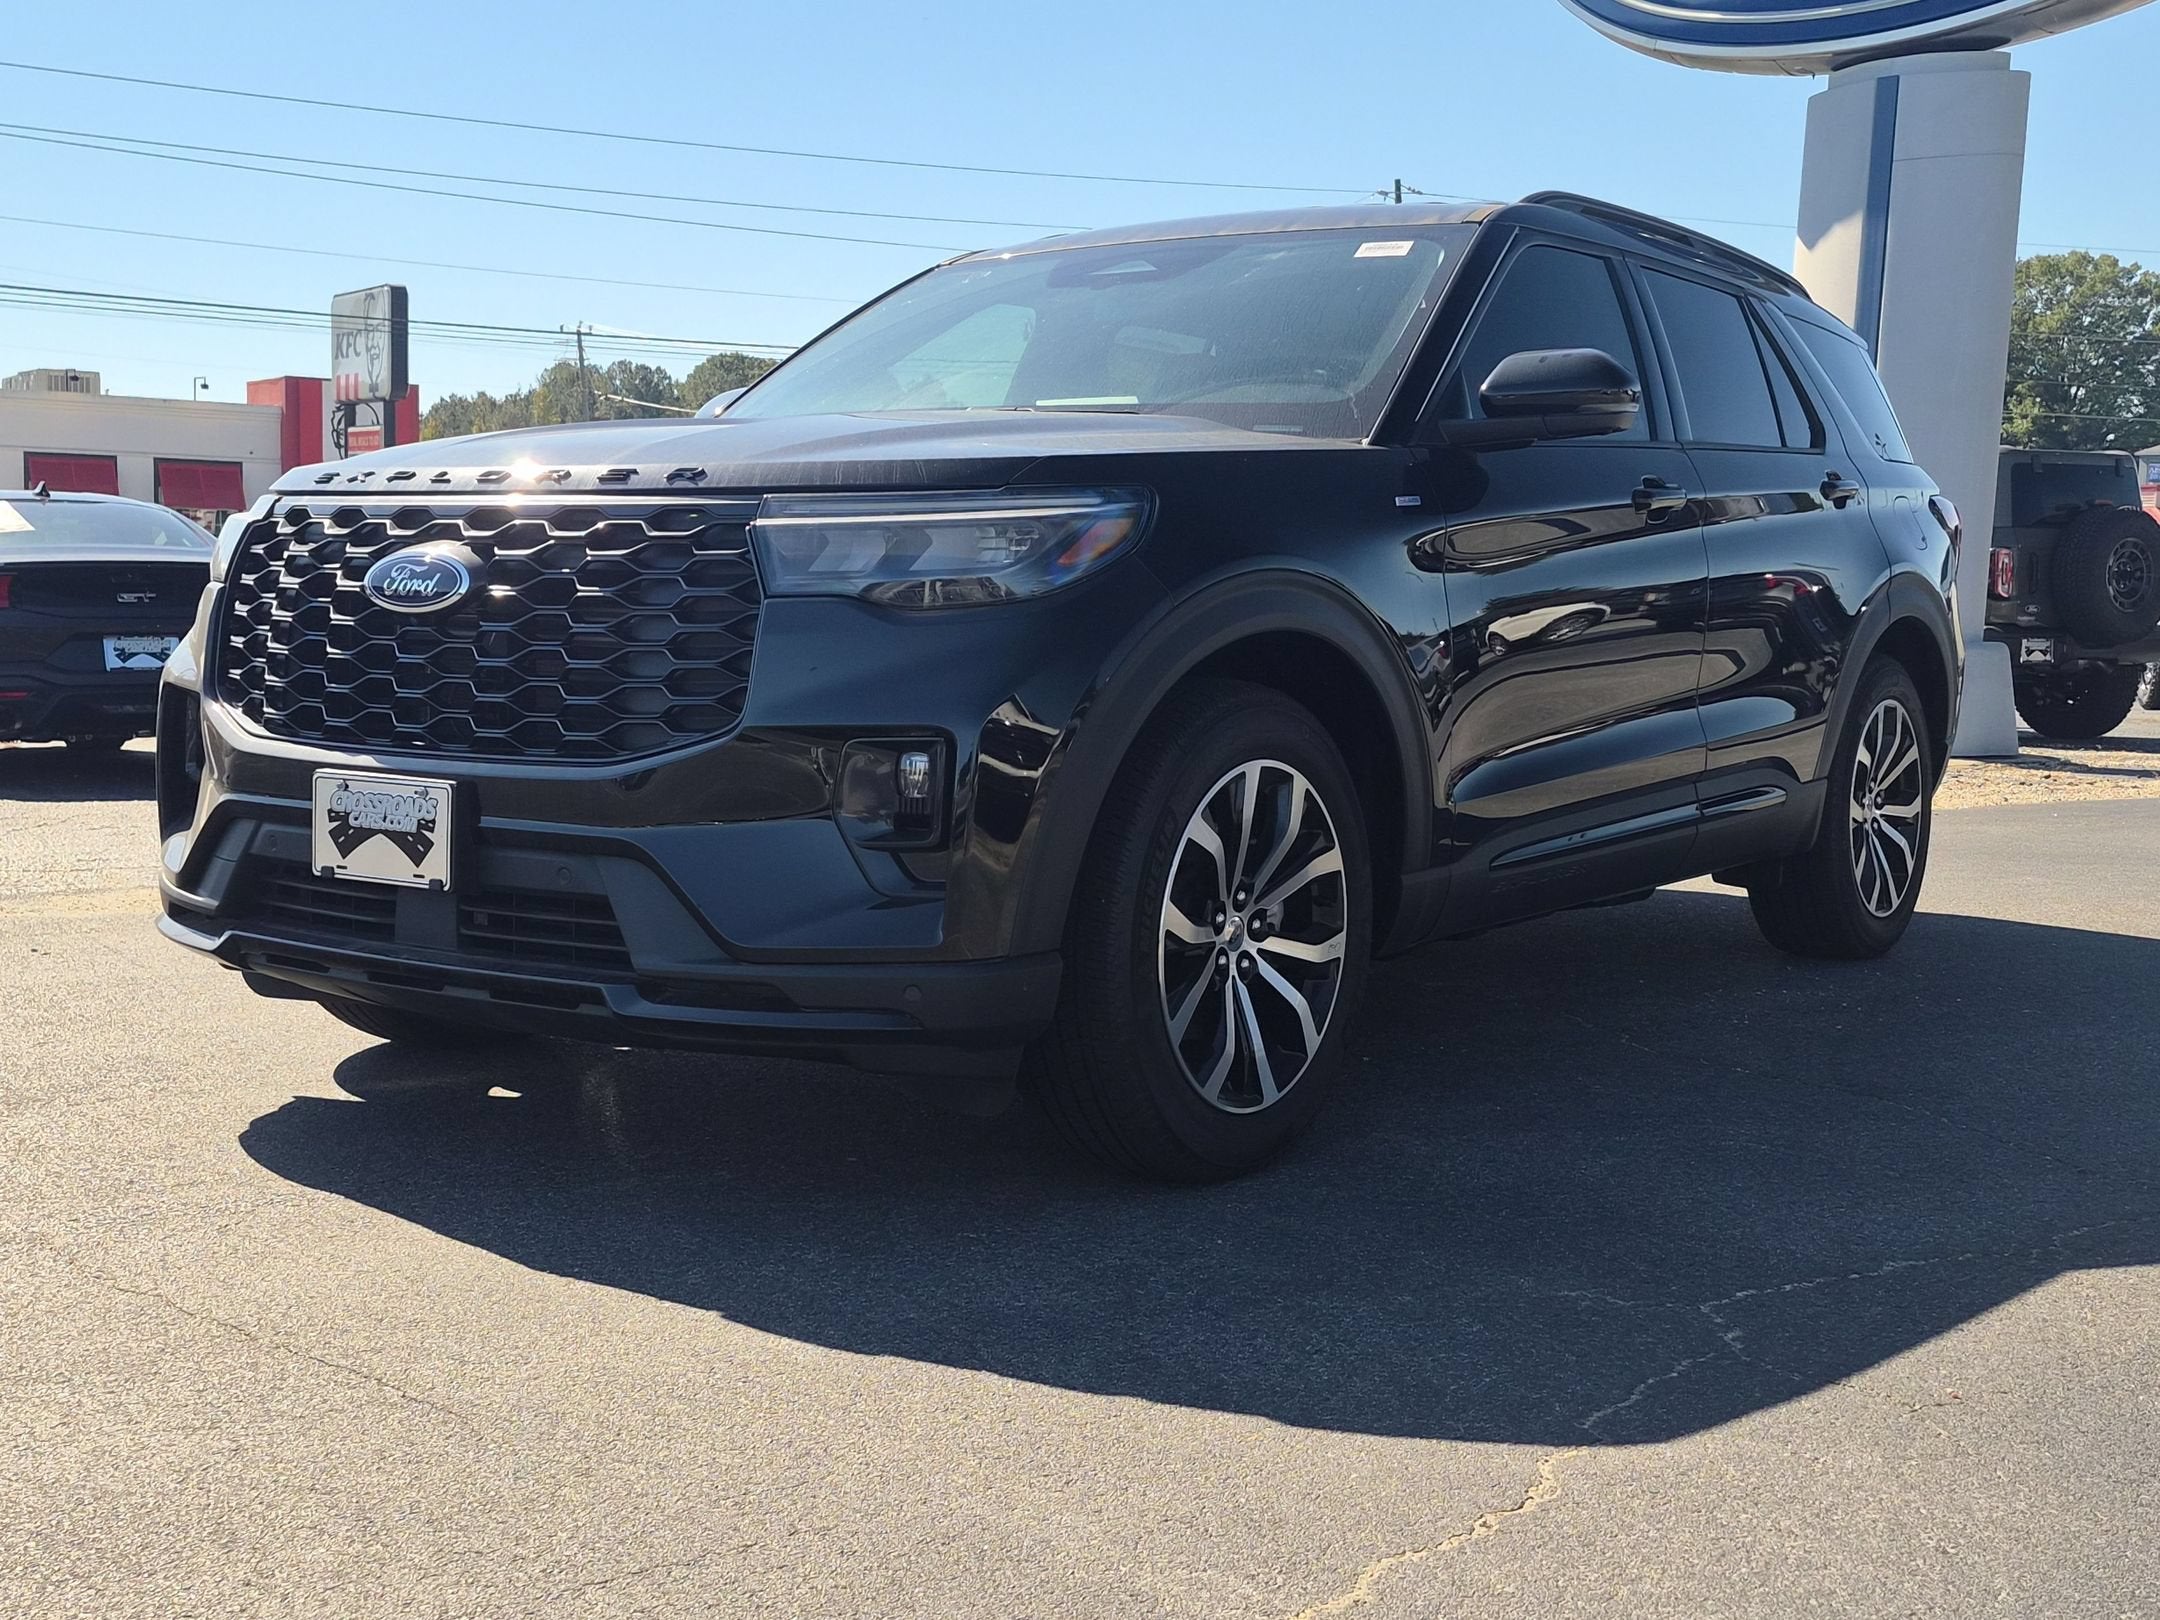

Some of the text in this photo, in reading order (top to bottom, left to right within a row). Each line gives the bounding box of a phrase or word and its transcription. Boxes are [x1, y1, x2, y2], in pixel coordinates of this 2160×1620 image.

[334, 331, 362, 359] KFC
[383, 563, 441, 596] Ford
[330, 790, 439, 821] CROSSROADS
